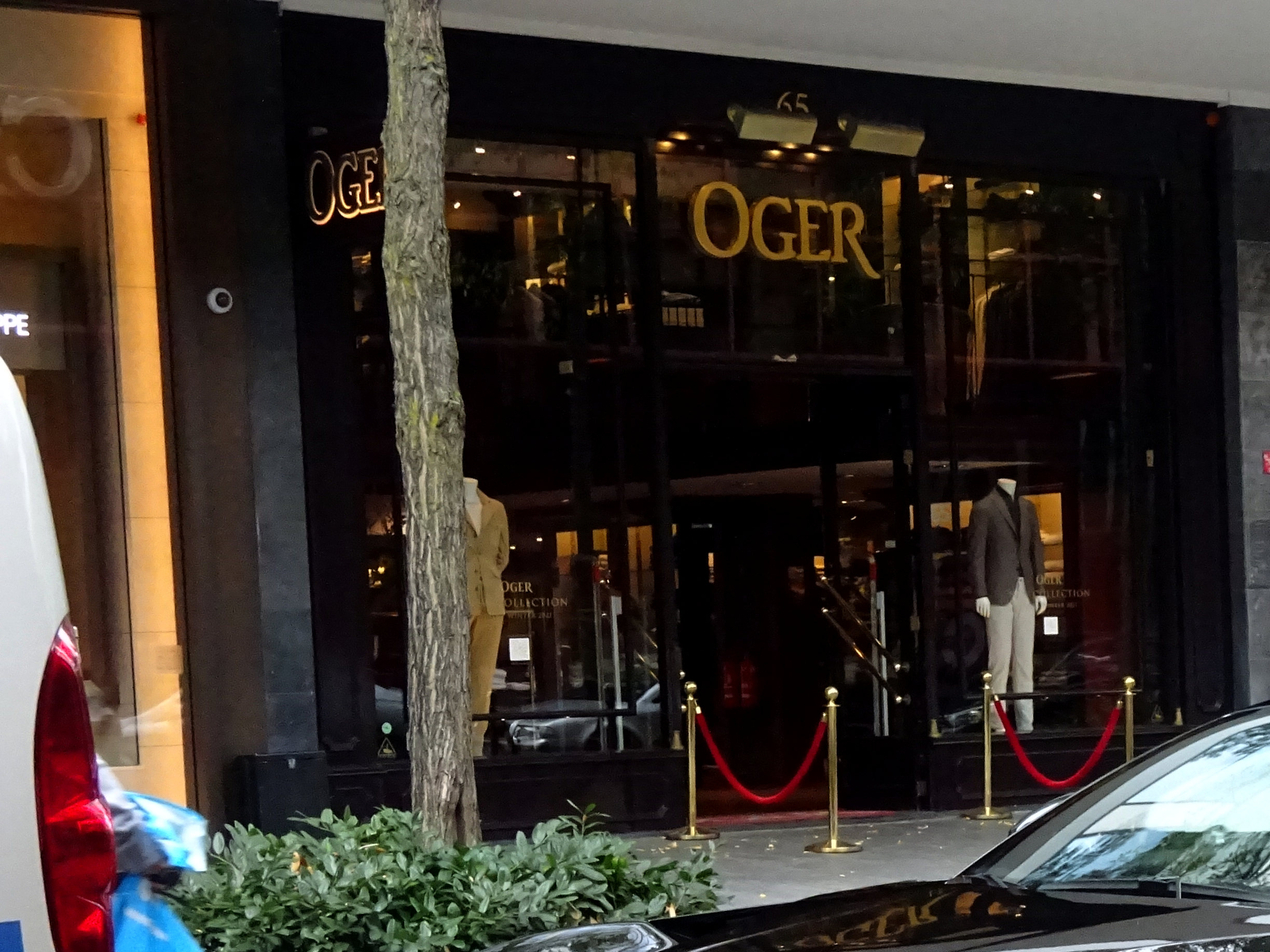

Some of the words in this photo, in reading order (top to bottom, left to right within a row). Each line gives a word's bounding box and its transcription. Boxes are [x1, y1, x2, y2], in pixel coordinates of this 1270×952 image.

[308, 148, 387, 225] OGE
[692, 180, 882, 279] OGER
[0, 312, 30, 336] PE
[502, 580, 534, 594] OGER
[504, 597, 568, 608] OLLECTION
